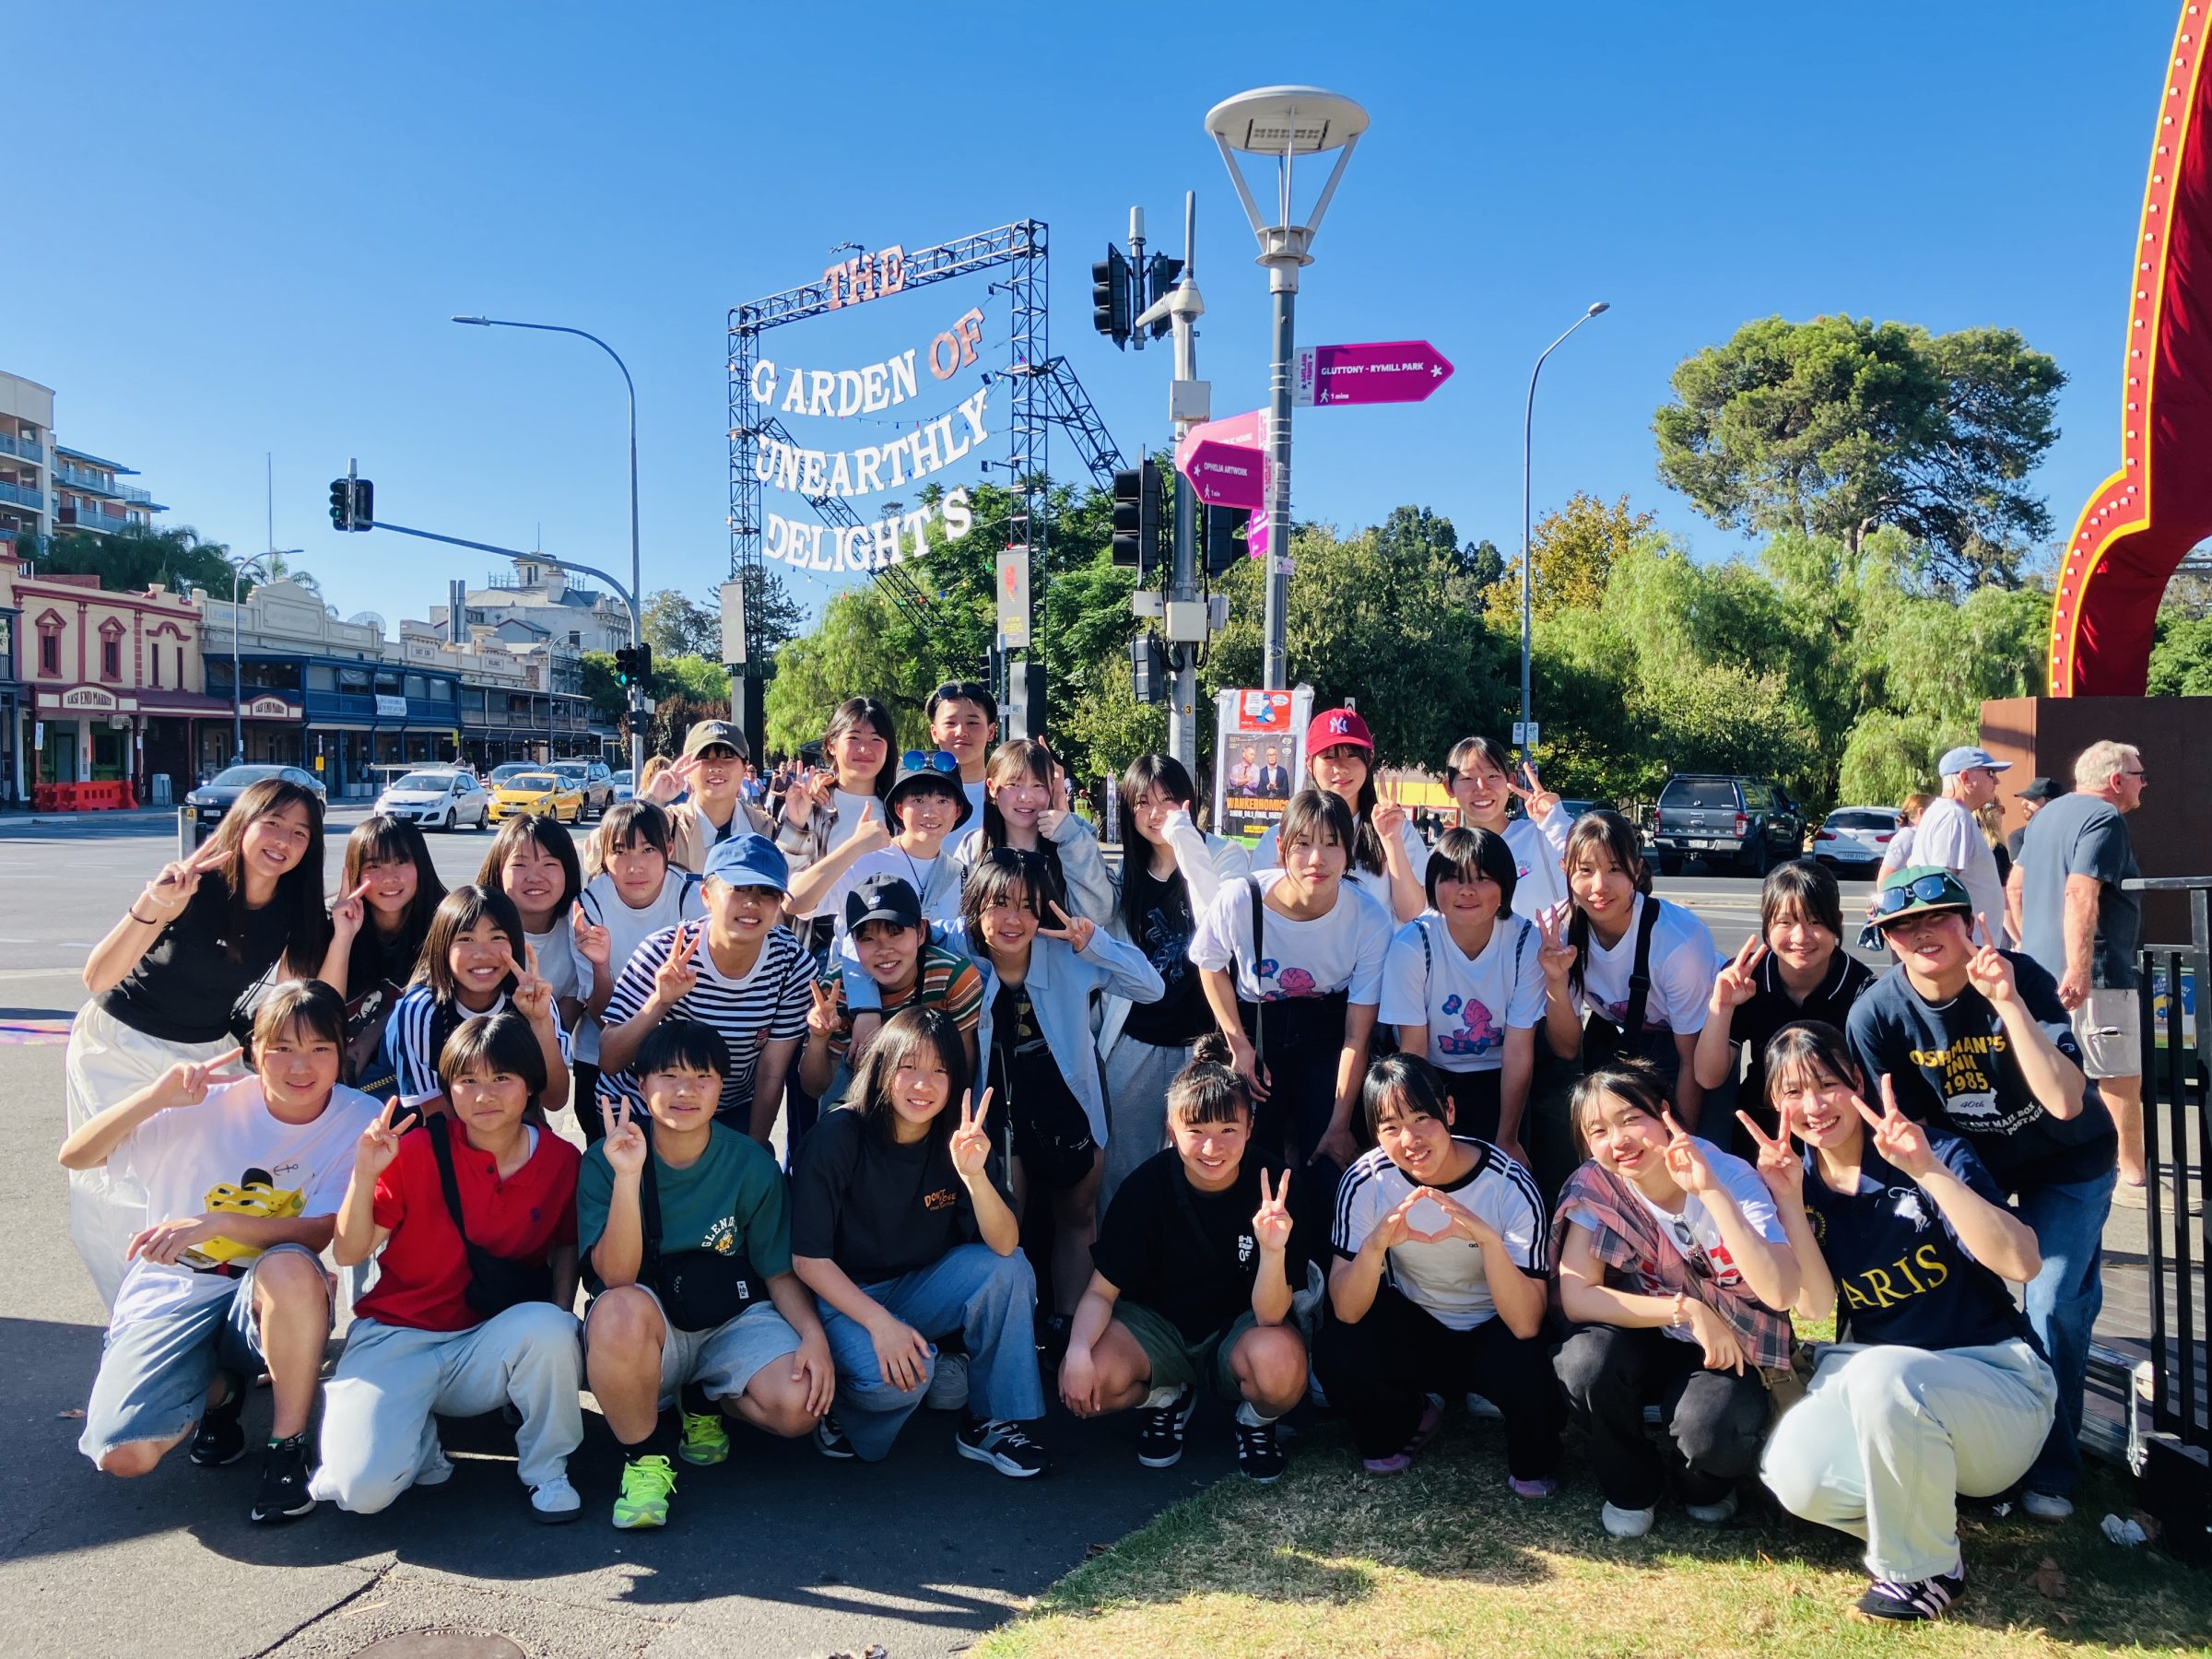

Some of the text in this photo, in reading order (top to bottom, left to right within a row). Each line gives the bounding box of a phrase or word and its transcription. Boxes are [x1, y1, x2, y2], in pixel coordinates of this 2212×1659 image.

[822, 244, 907, 310] THE
[750, 307, 985, 418] GARDEN OF
[1321, 365, 1364, 375] GLUTTONY
[1371, 364, 1401, 373] RYMILL
[1402, 362, 1424, 371] PARK
[754, 388, 989, 498] UNEARTHLY
[1225, 465, 1248, 477] ARTWORK
[762, 487, 974, 572] DELIGHTS
[67, 691, 112, 706] EAST END MARKET
[255, 701, 285, 714] EAST END MARKET
[1185, 705, 1192, 714] 3
[1329, 716, 1348, 735] NY
[1909, 1035, 2006, 1067] OSHMAN'S
[1946, 1053, 1978, 1078] INN
[1944, 1071, 1989, 1095] 1985
[1959, 1100, 1984, 1109] 40th
[1992, 1112, 2017, 1128] MAIL
[2018, 1101, 2036, 1117] BOX
[2006, 1105, 2044, 1135] POSTAGE
[1833, 1244, 1947, 1310] ARIS
